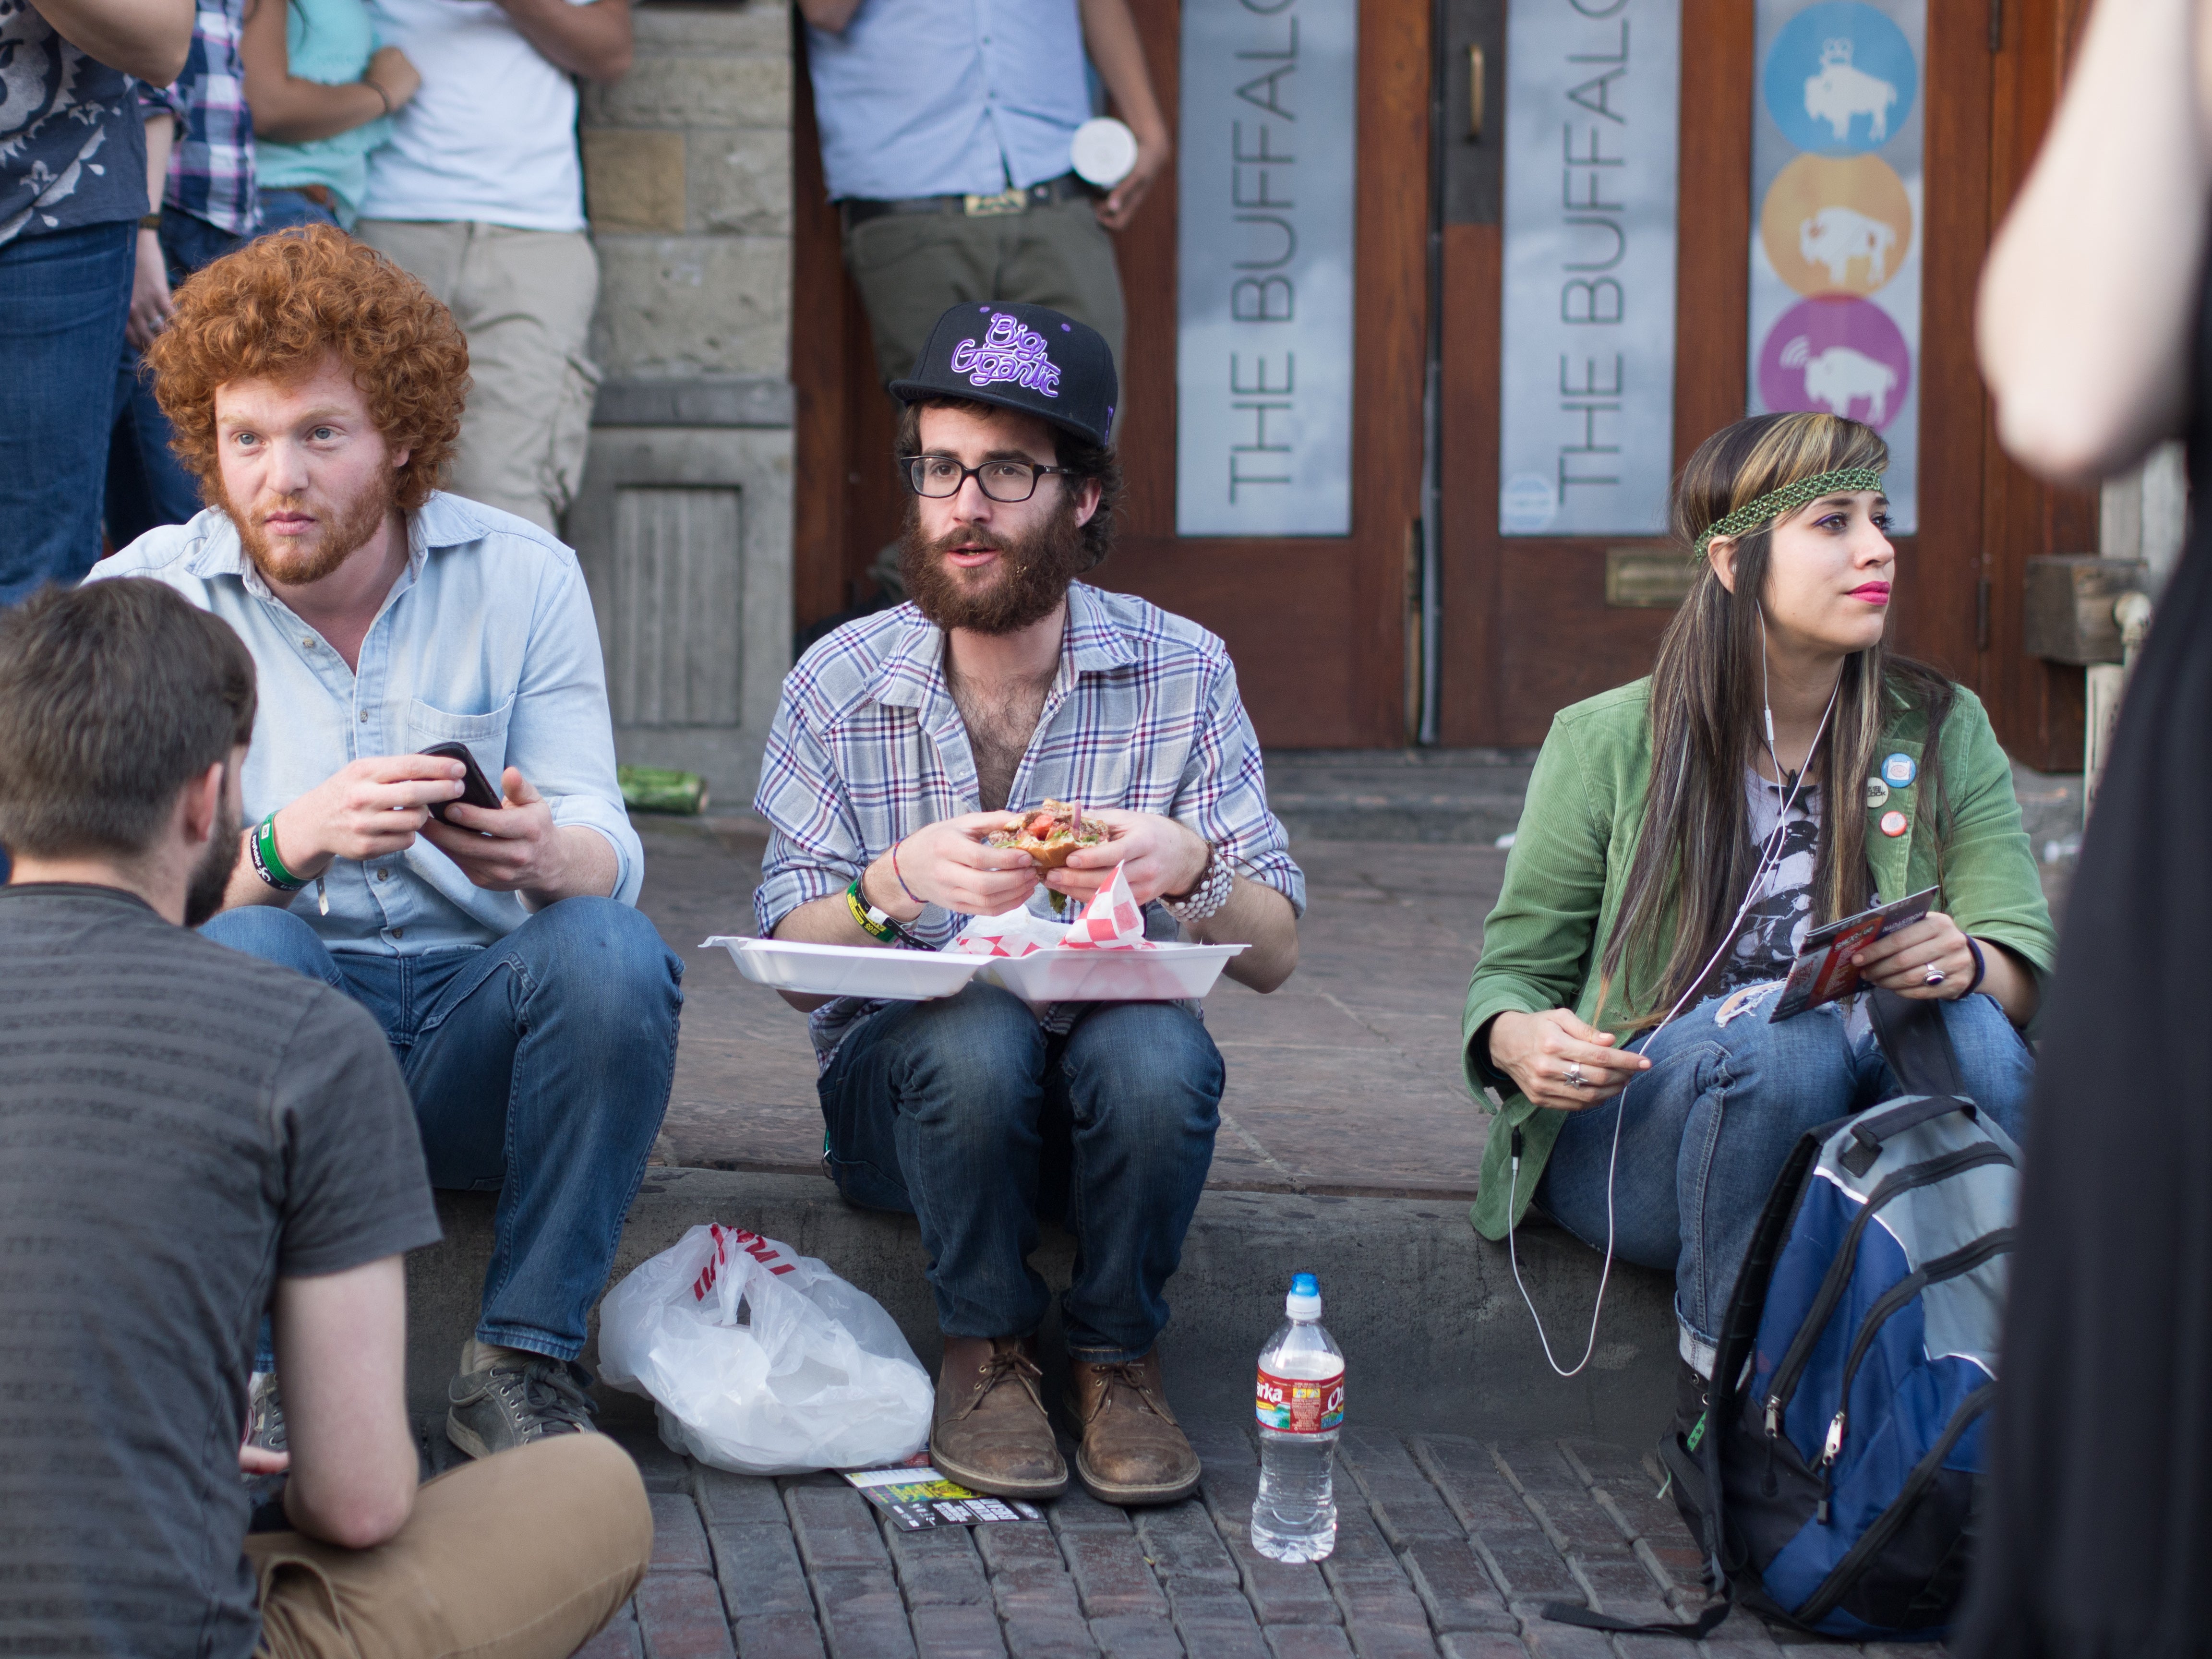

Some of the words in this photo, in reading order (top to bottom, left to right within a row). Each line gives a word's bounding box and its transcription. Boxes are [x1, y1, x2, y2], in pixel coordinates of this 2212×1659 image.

[986, 313, 1047, 361] Big
[951, 338, 1061, 397] Gigantic
[1229, 349, 1294, 505] THE
[1558, 354, 1623, 505] THE
[1257, 1381, 1283, 1403] arka
